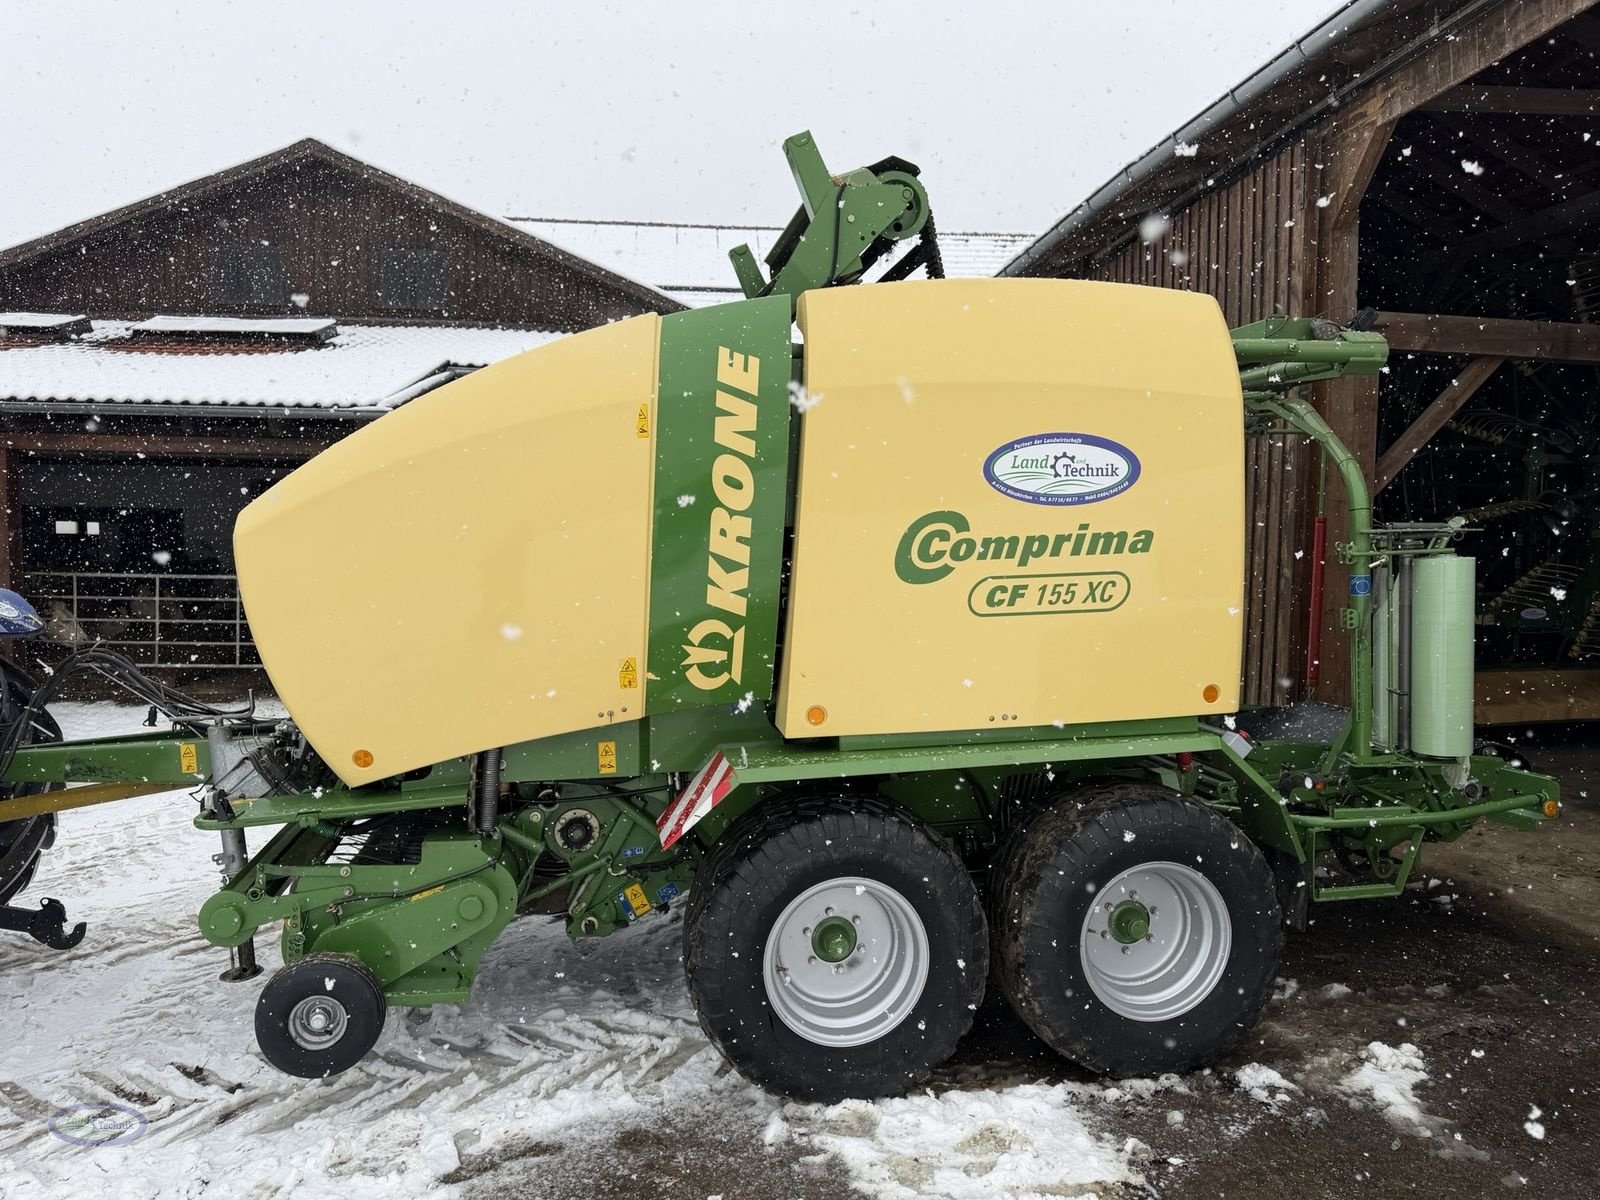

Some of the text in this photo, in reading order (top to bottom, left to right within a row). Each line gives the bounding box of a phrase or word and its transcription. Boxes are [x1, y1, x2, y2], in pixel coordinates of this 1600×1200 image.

[1014, 441, 1033, 449] Partner
[1010, 455, 1050, 469] Land
[1062, 463, 1120, 477] Technik
[706, 345, 760, 617] KRONE
[894, 510, 1154, 585] Comprima
[985, 580, 1117, 607] CF 155 XC
